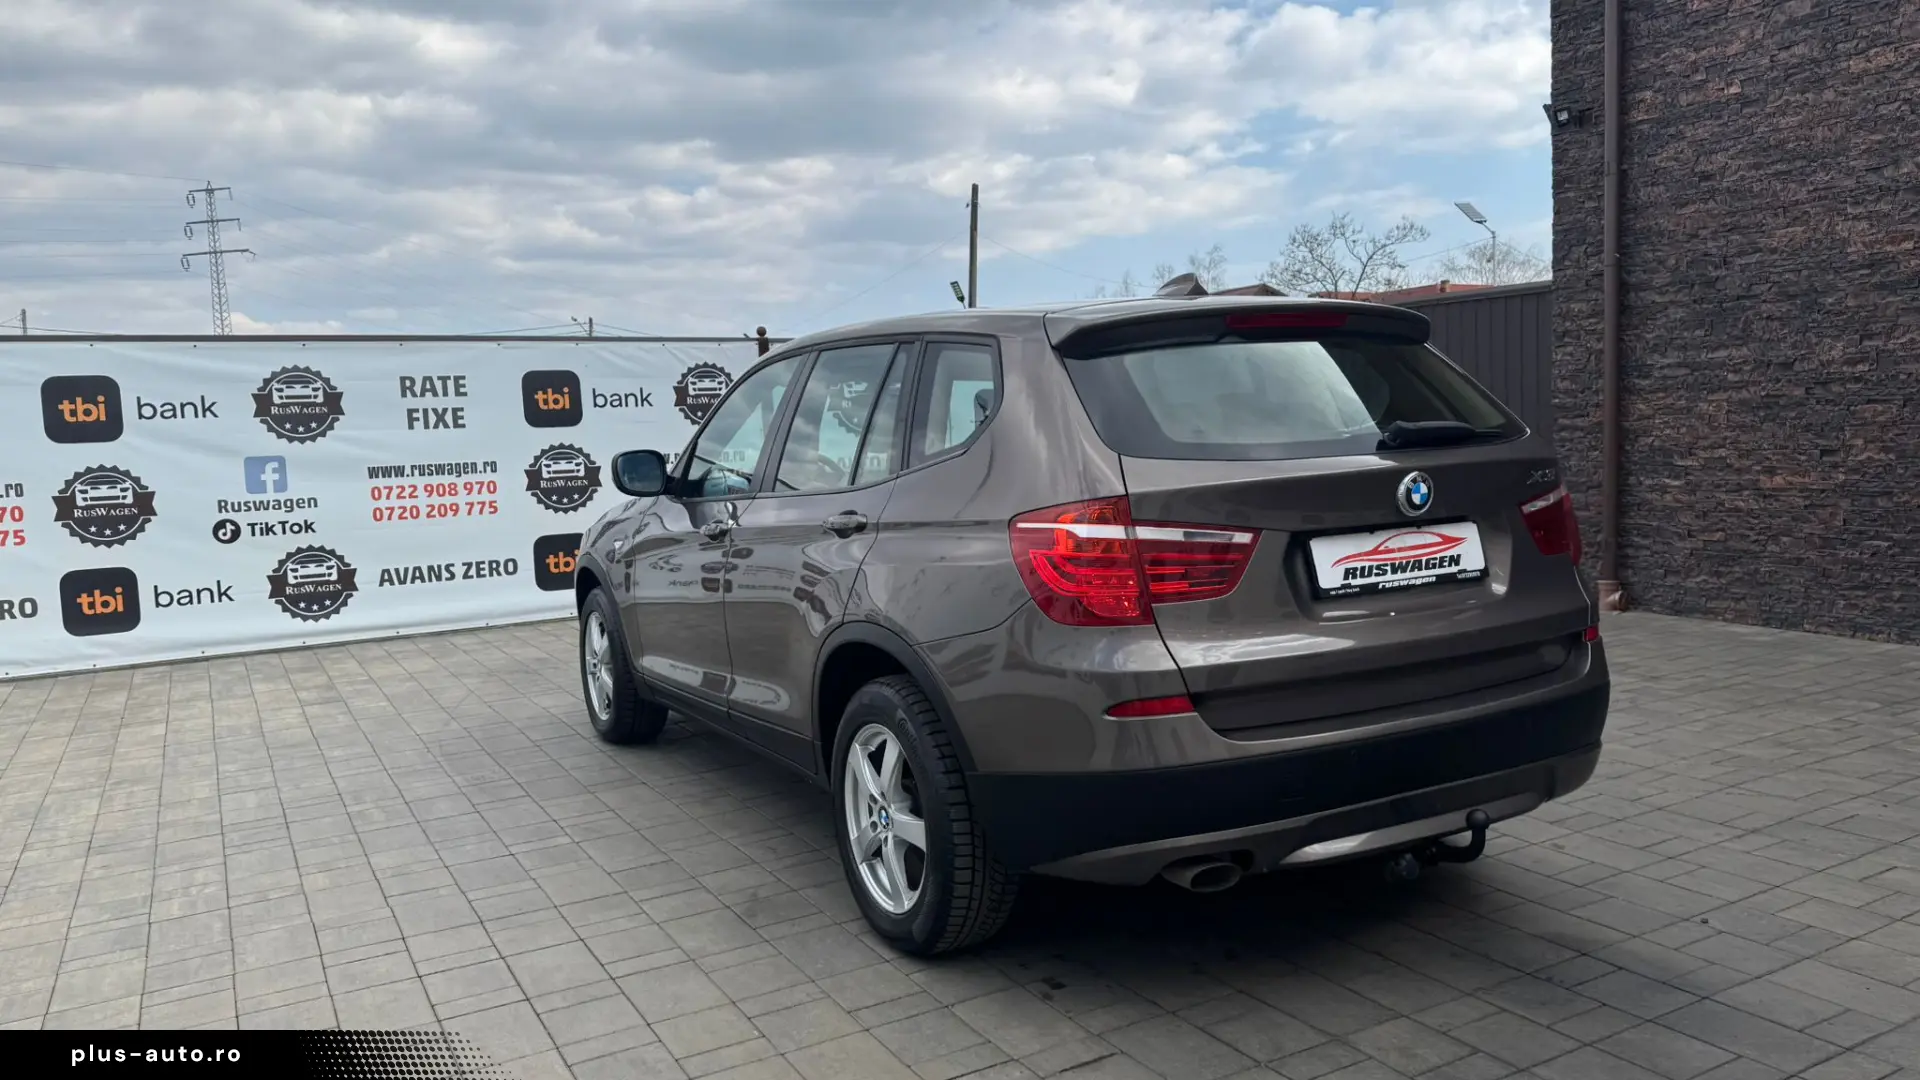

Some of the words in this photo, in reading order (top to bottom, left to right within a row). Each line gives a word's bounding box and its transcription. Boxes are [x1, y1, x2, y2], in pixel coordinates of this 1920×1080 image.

[399, 375, 468, 399] RATE
[534, 386, 570, 410] tbi
[592, 387, 653, 409] bank
[58, 395, 107, 422] tbi
[136, 395, 219, 420] bank
[407, 407, 467, 430] FIXE
[367, 461, 498, 479] www.ruswagen.ro
[370, 484, 419, 501] 0722
[424, 482, 459, 498] 908
[463, 480, 498, 496] 970
[217, 496, 318, 517] Ruswagen
[372, 505, 421, 522] 0720
[426, 502, 460, 519] 209
[465, 500, 499, 516] 775
[247, 520, 316, 538] TikTok
[378, 563, 456, 587] AVANS
[461, 558, 518, 580] ZERO
[546, 549, 580, 574] tb
[1343, 554, 1462, 581] RUSWAGEN
[1378, 576, 1436, 590] ruswagen
[77, 587, 124, 615] tbi
[153, 580, 235, 609] bank
